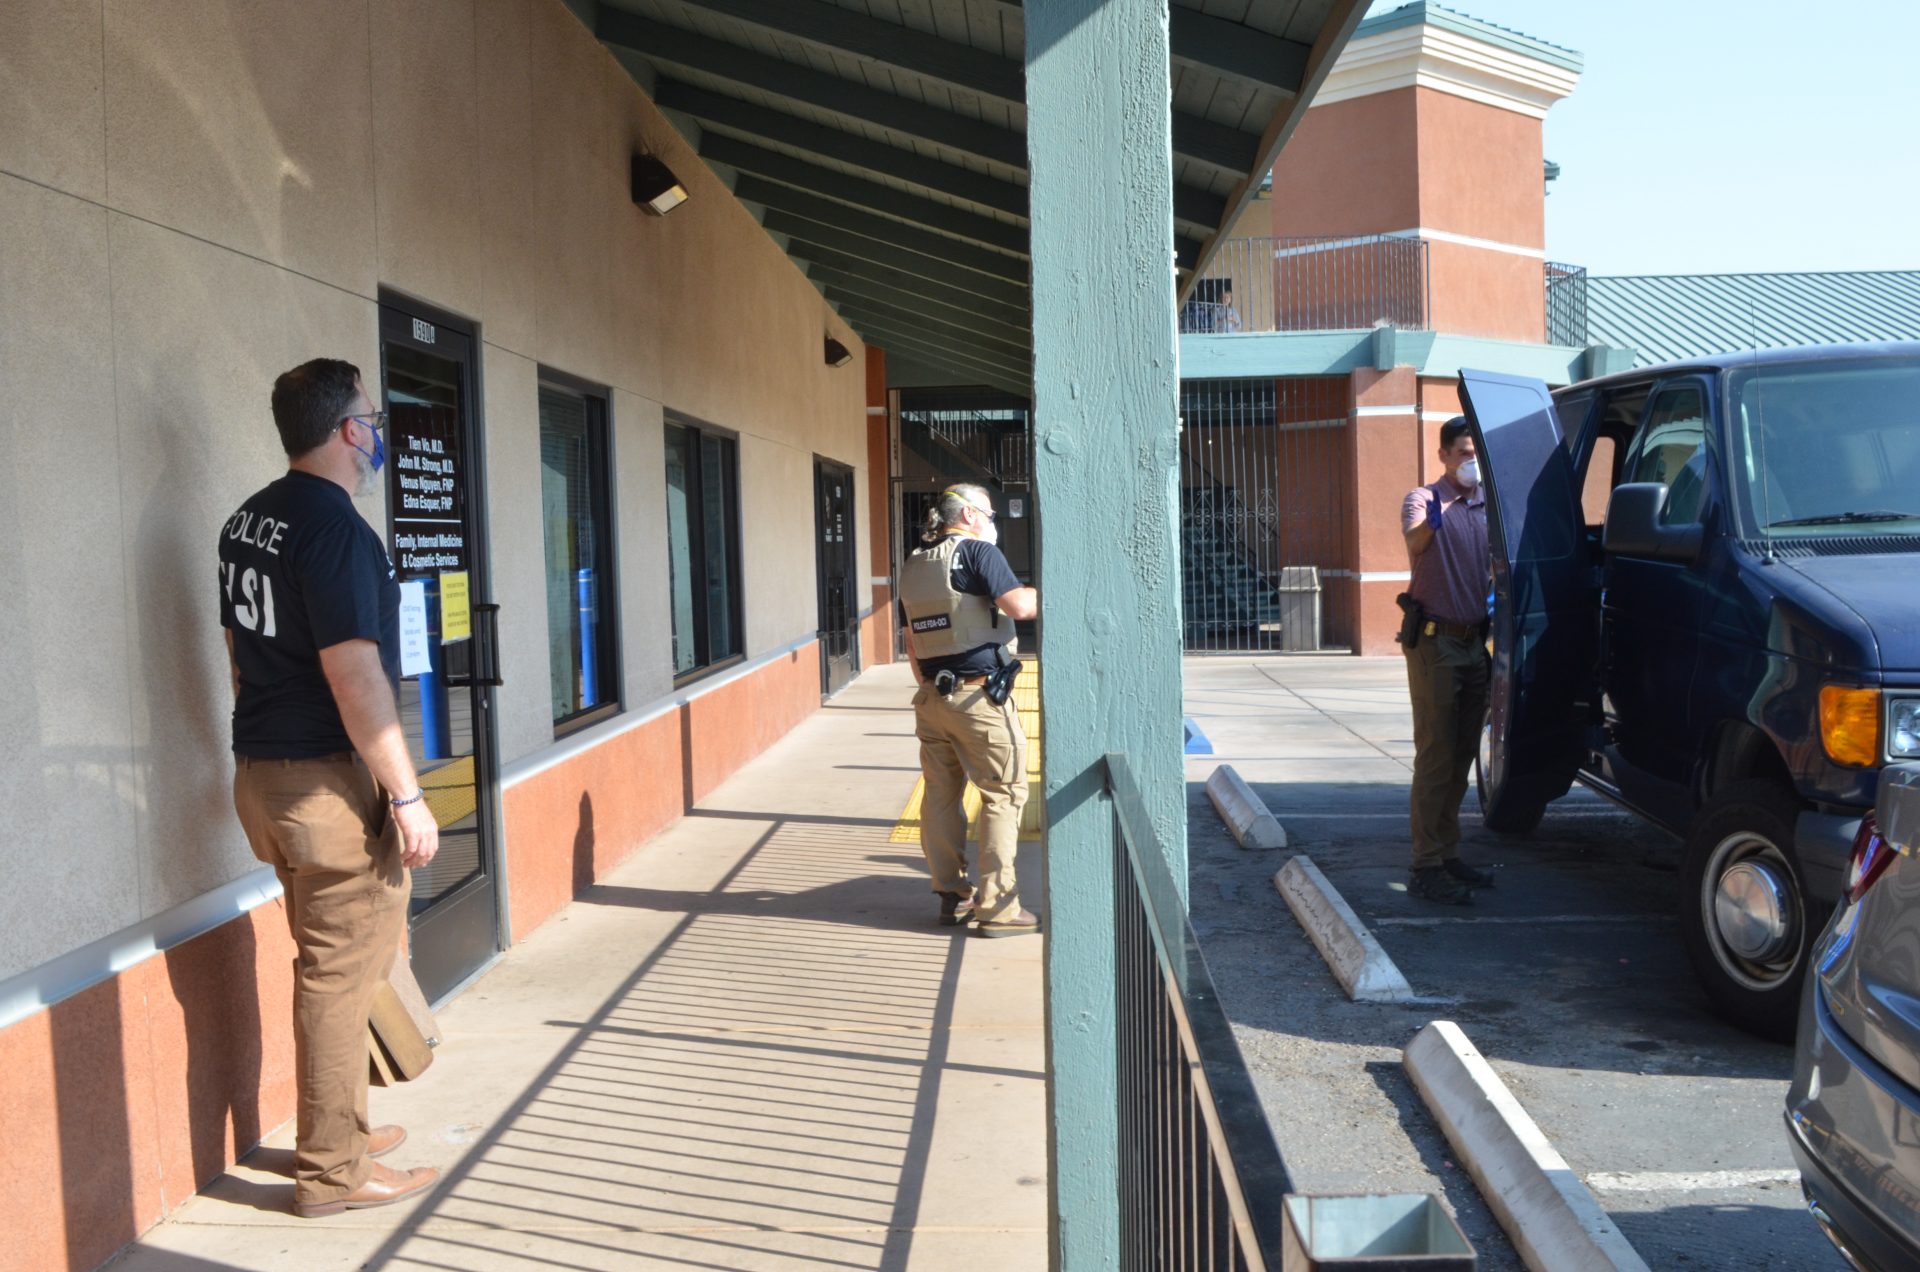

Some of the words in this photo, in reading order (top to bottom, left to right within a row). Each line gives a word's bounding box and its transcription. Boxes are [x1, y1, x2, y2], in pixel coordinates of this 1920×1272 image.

[408, 435, 421, 450] Tien
[398, 454, 413, 469] John
[413, 456, 421, 470] M.
[421, 457, 442, 476] Strong,
[400, 474, 418, 489] Venus
[442, 478, 454, 492] FNP
[403, 494, 419, 508] Edna
[441, 496, 453, 510] FNP
[395, 533, 417, 551] Family,
[417, 533, 438, 548] Internal
[439, 533, 463, 548] Medicine
[402, 553, 408, 568] &
[408, 553, 435, 568] Cosmetic
[435, 552, 459, 567] Services
[913, 620, 928, 631] POLICE
